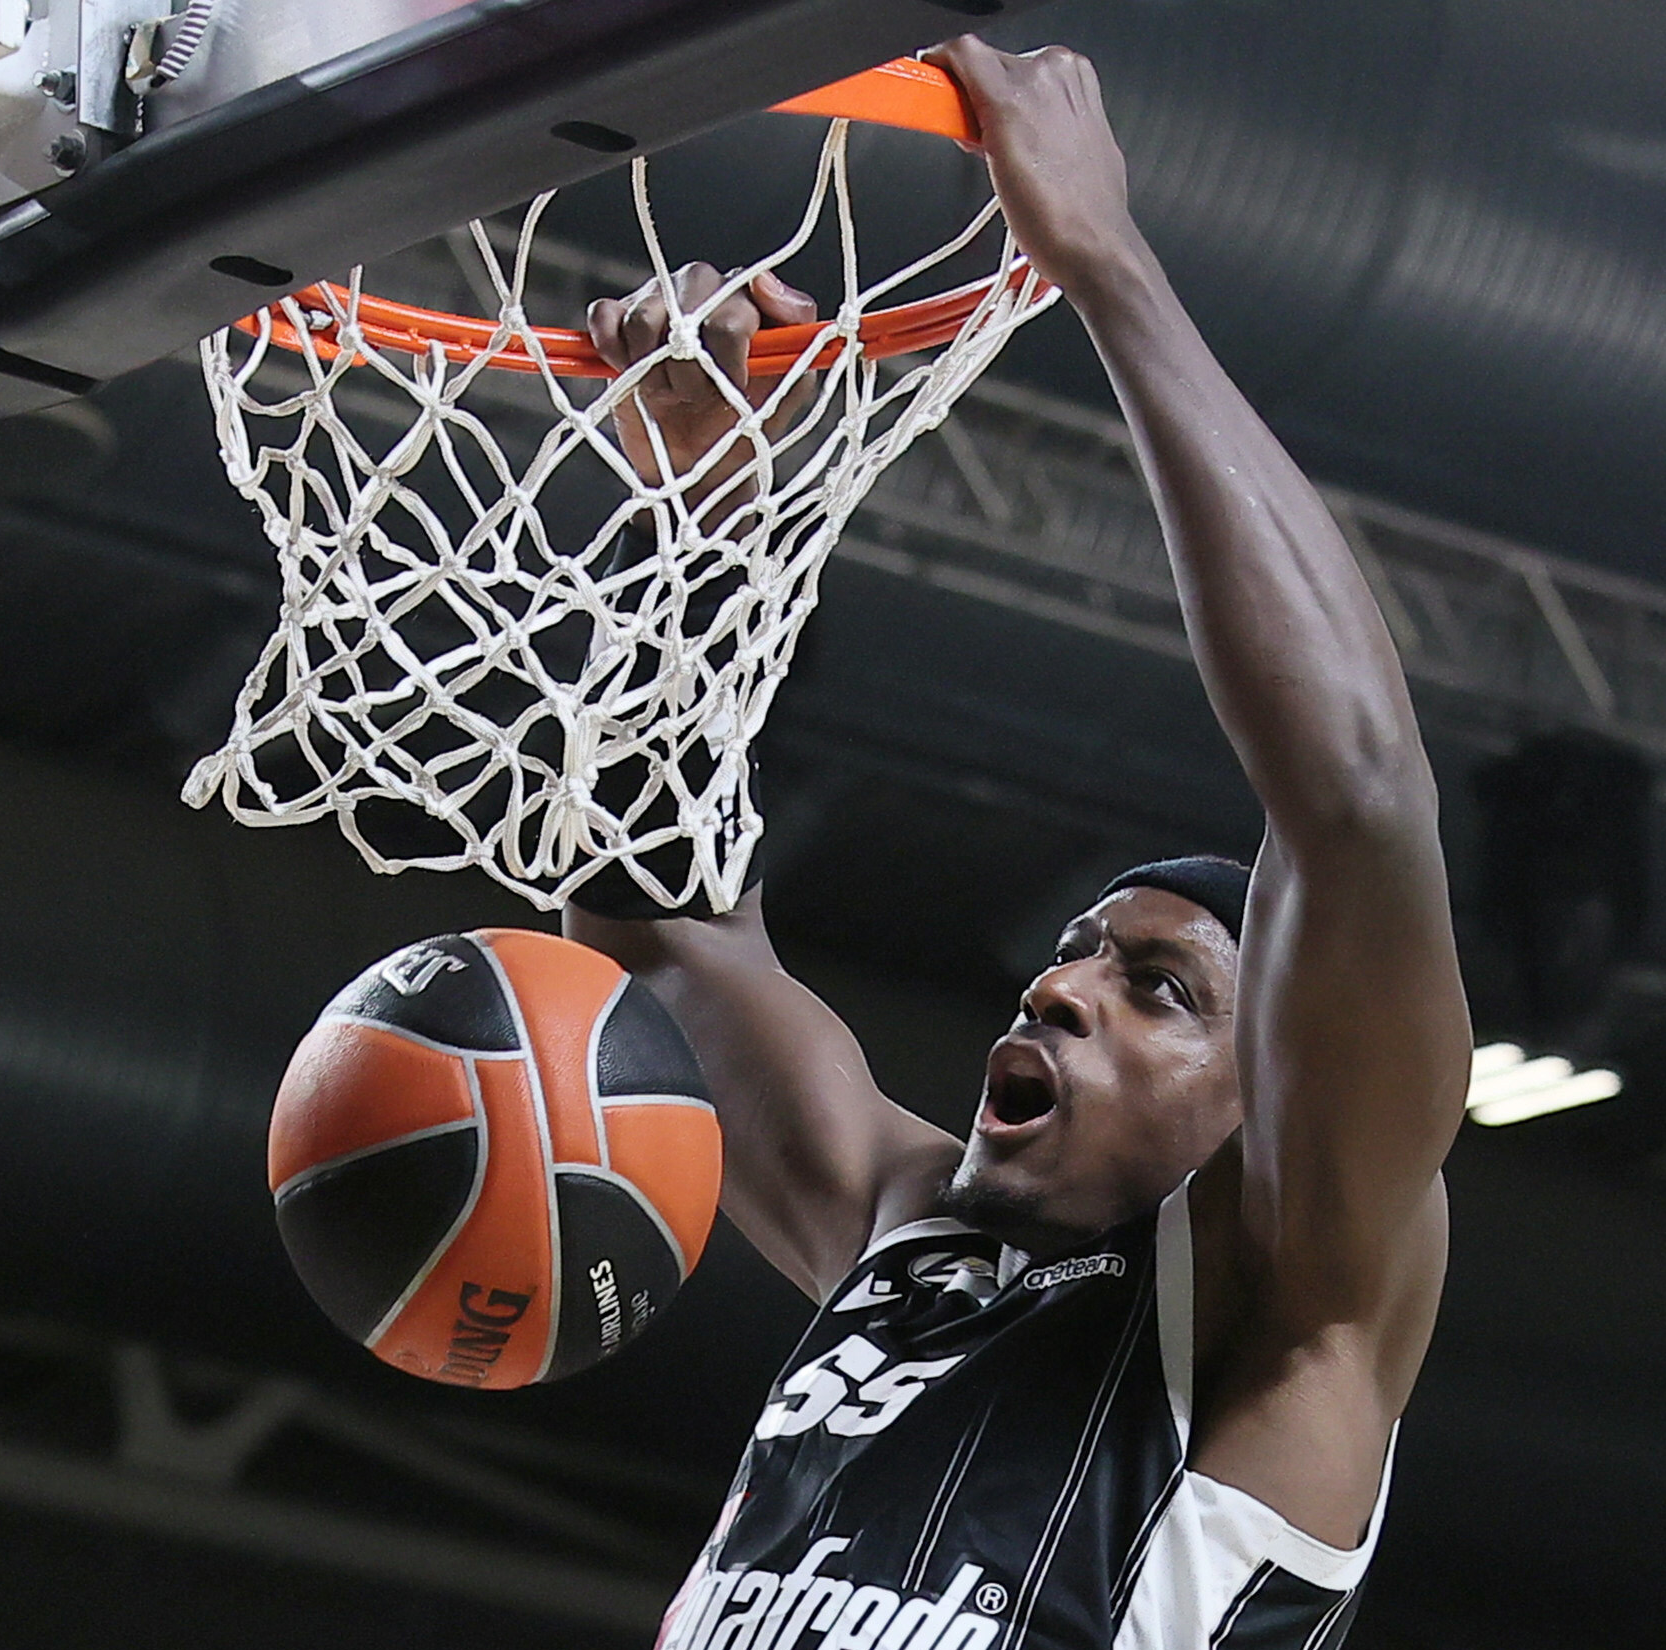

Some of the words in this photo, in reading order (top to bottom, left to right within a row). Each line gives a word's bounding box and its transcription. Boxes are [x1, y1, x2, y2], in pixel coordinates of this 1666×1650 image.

[588, 1259, 622, 1347] AIRLINES
[1024, 1254, 1127, 1290] oneteam
[438, 1281, 532, 1384] DING
[754, 1334, 968, 1441] 55
